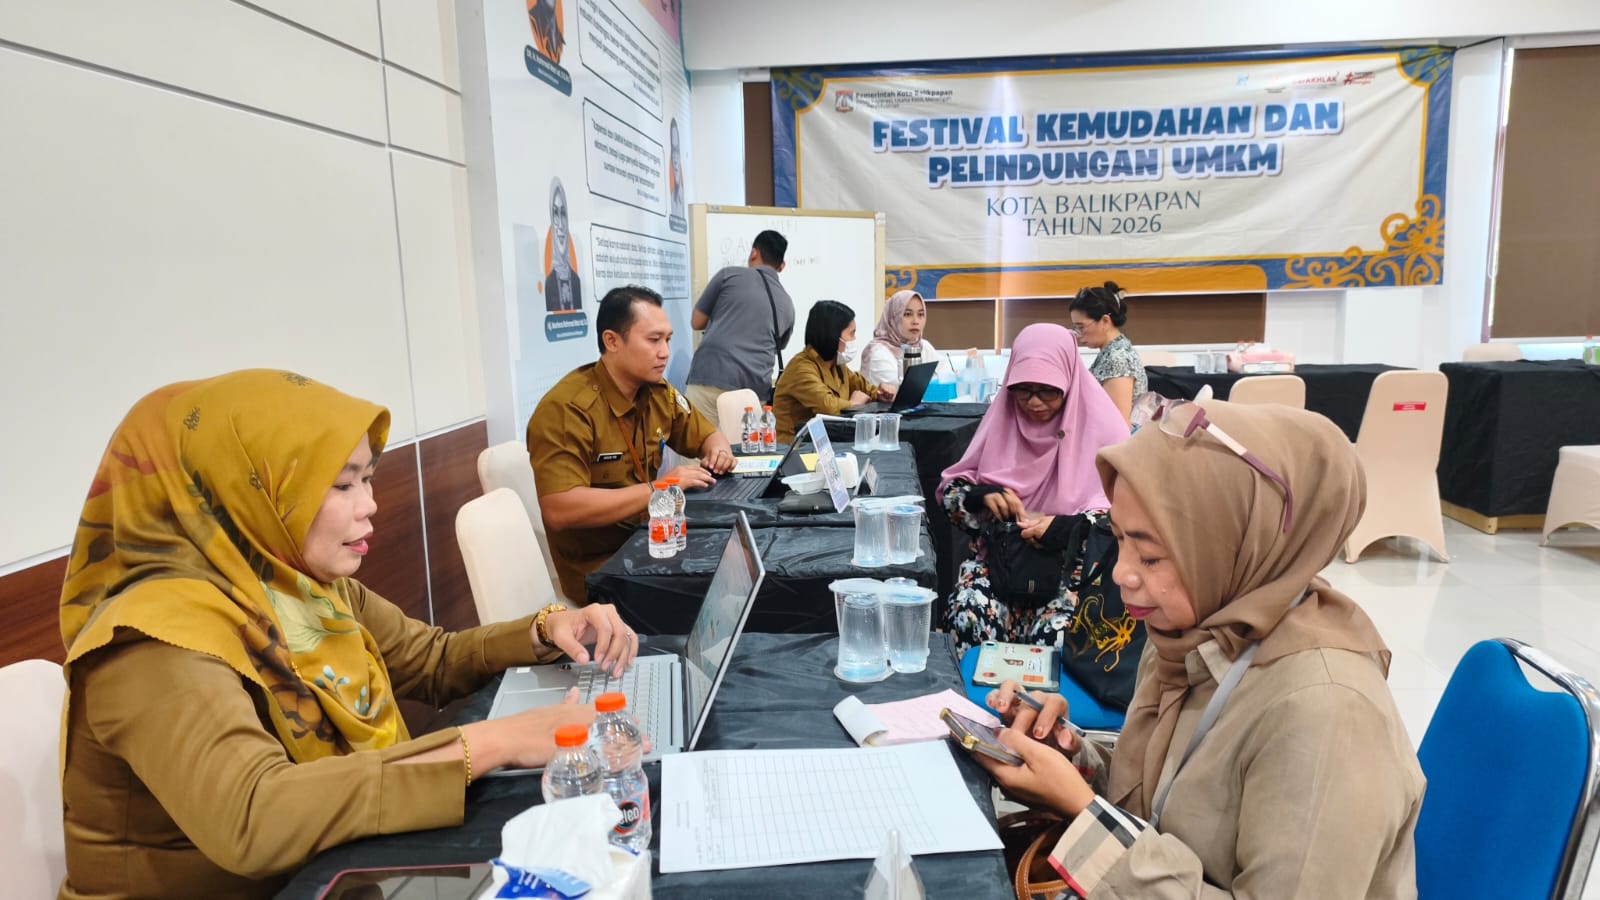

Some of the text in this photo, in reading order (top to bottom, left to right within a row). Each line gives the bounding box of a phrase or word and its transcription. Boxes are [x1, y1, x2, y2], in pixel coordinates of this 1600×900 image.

[873, 102, 1339, 148] FESTIVAL KEMUDAHAN DAN
[929, 143, 1278, 183] PELINDUNGAN UMKM
[987, 190, 1202, 216] KOTA BALIKPAPAN
[1022, 214, 1162, 236] TAHUN 2026
